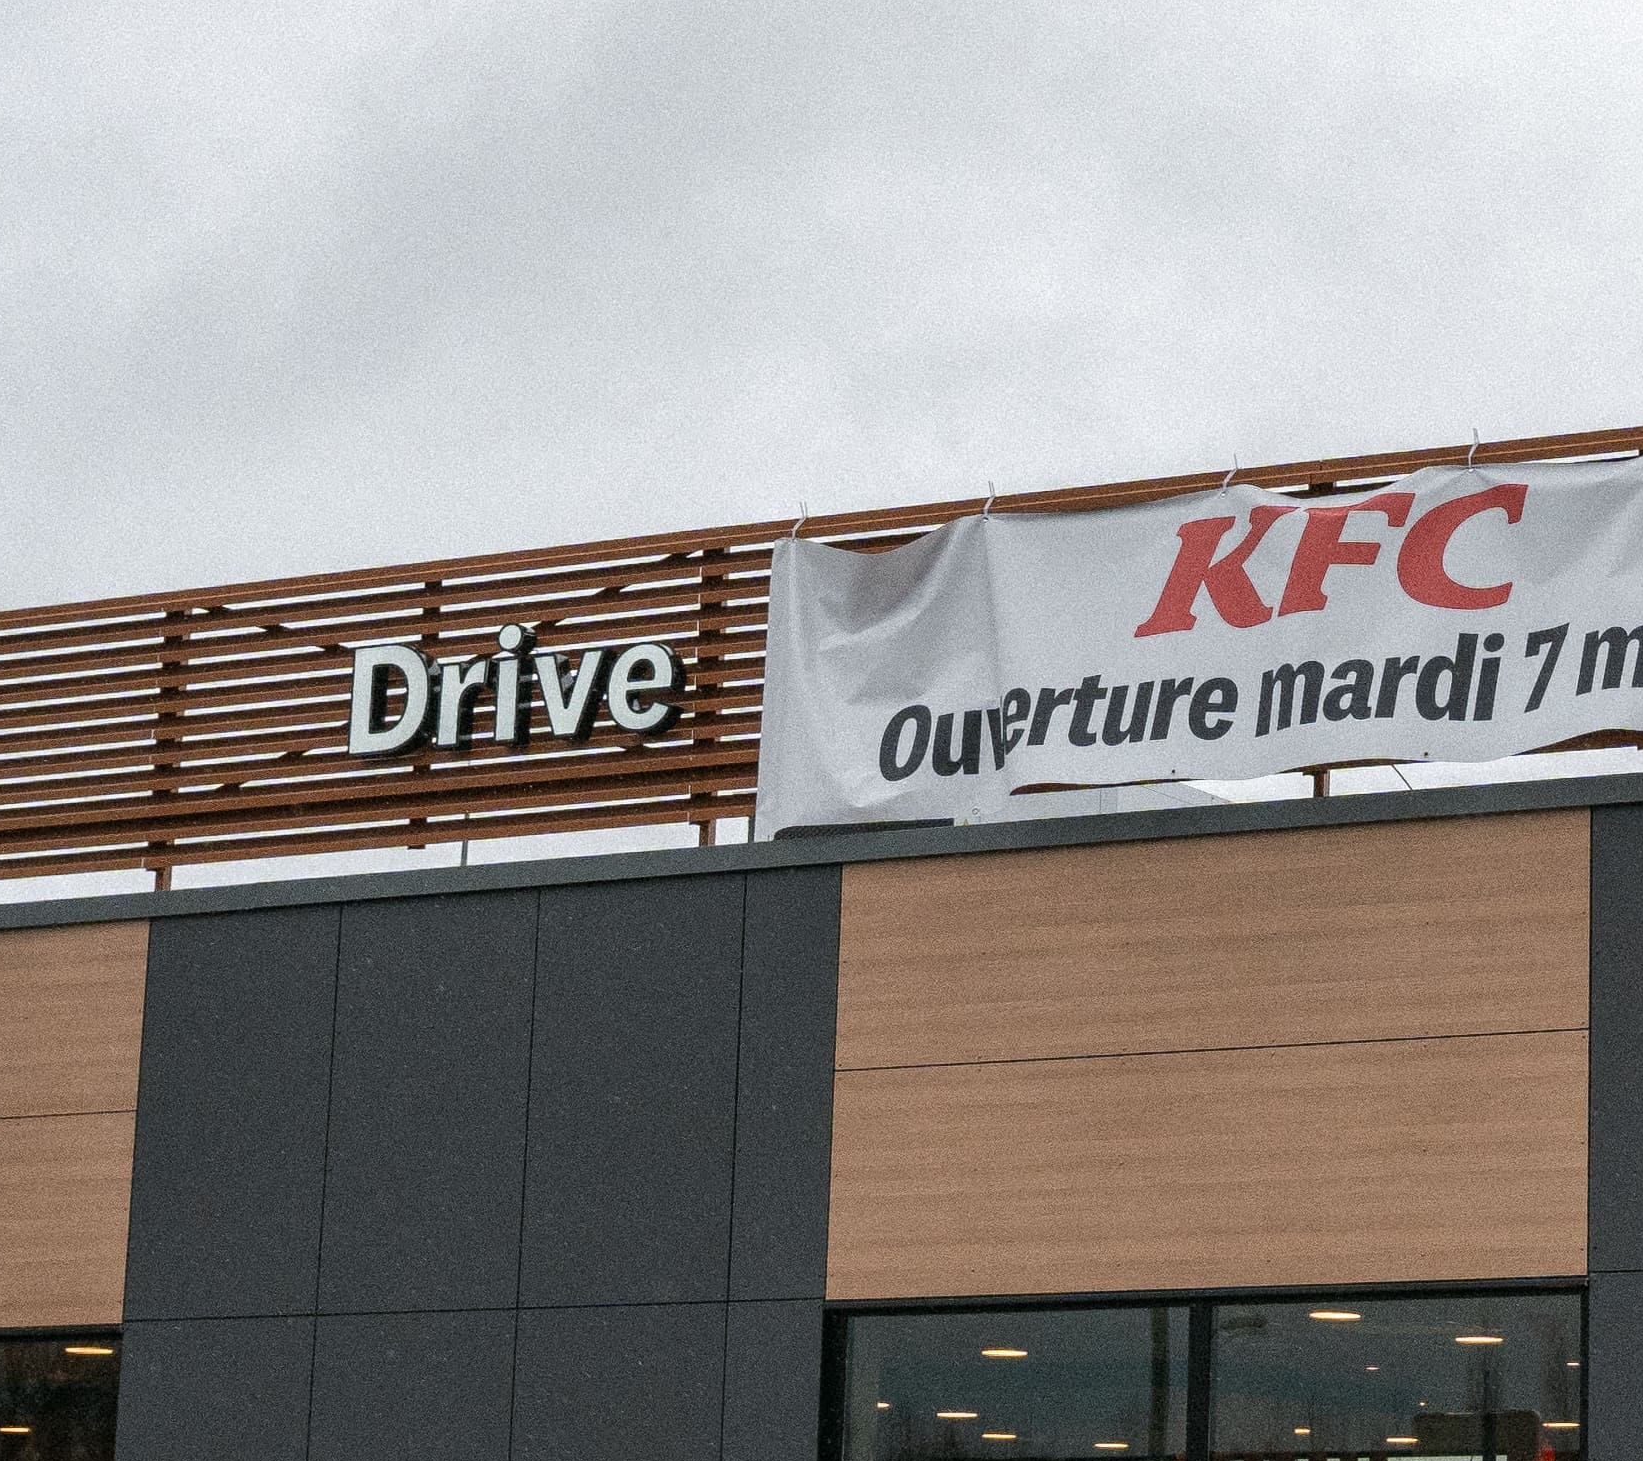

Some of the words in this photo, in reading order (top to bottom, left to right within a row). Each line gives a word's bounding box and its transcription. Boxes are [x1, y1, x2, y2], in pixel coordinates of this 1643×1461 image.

[1134, 483, 1529, 638] KFC
[347, 622, 678, 757] Drive
[878, 674, 1238, 782] Ouverture
[1256, 632, 1505, 738] mardi
[1524, 622, 1570, 714] 7
